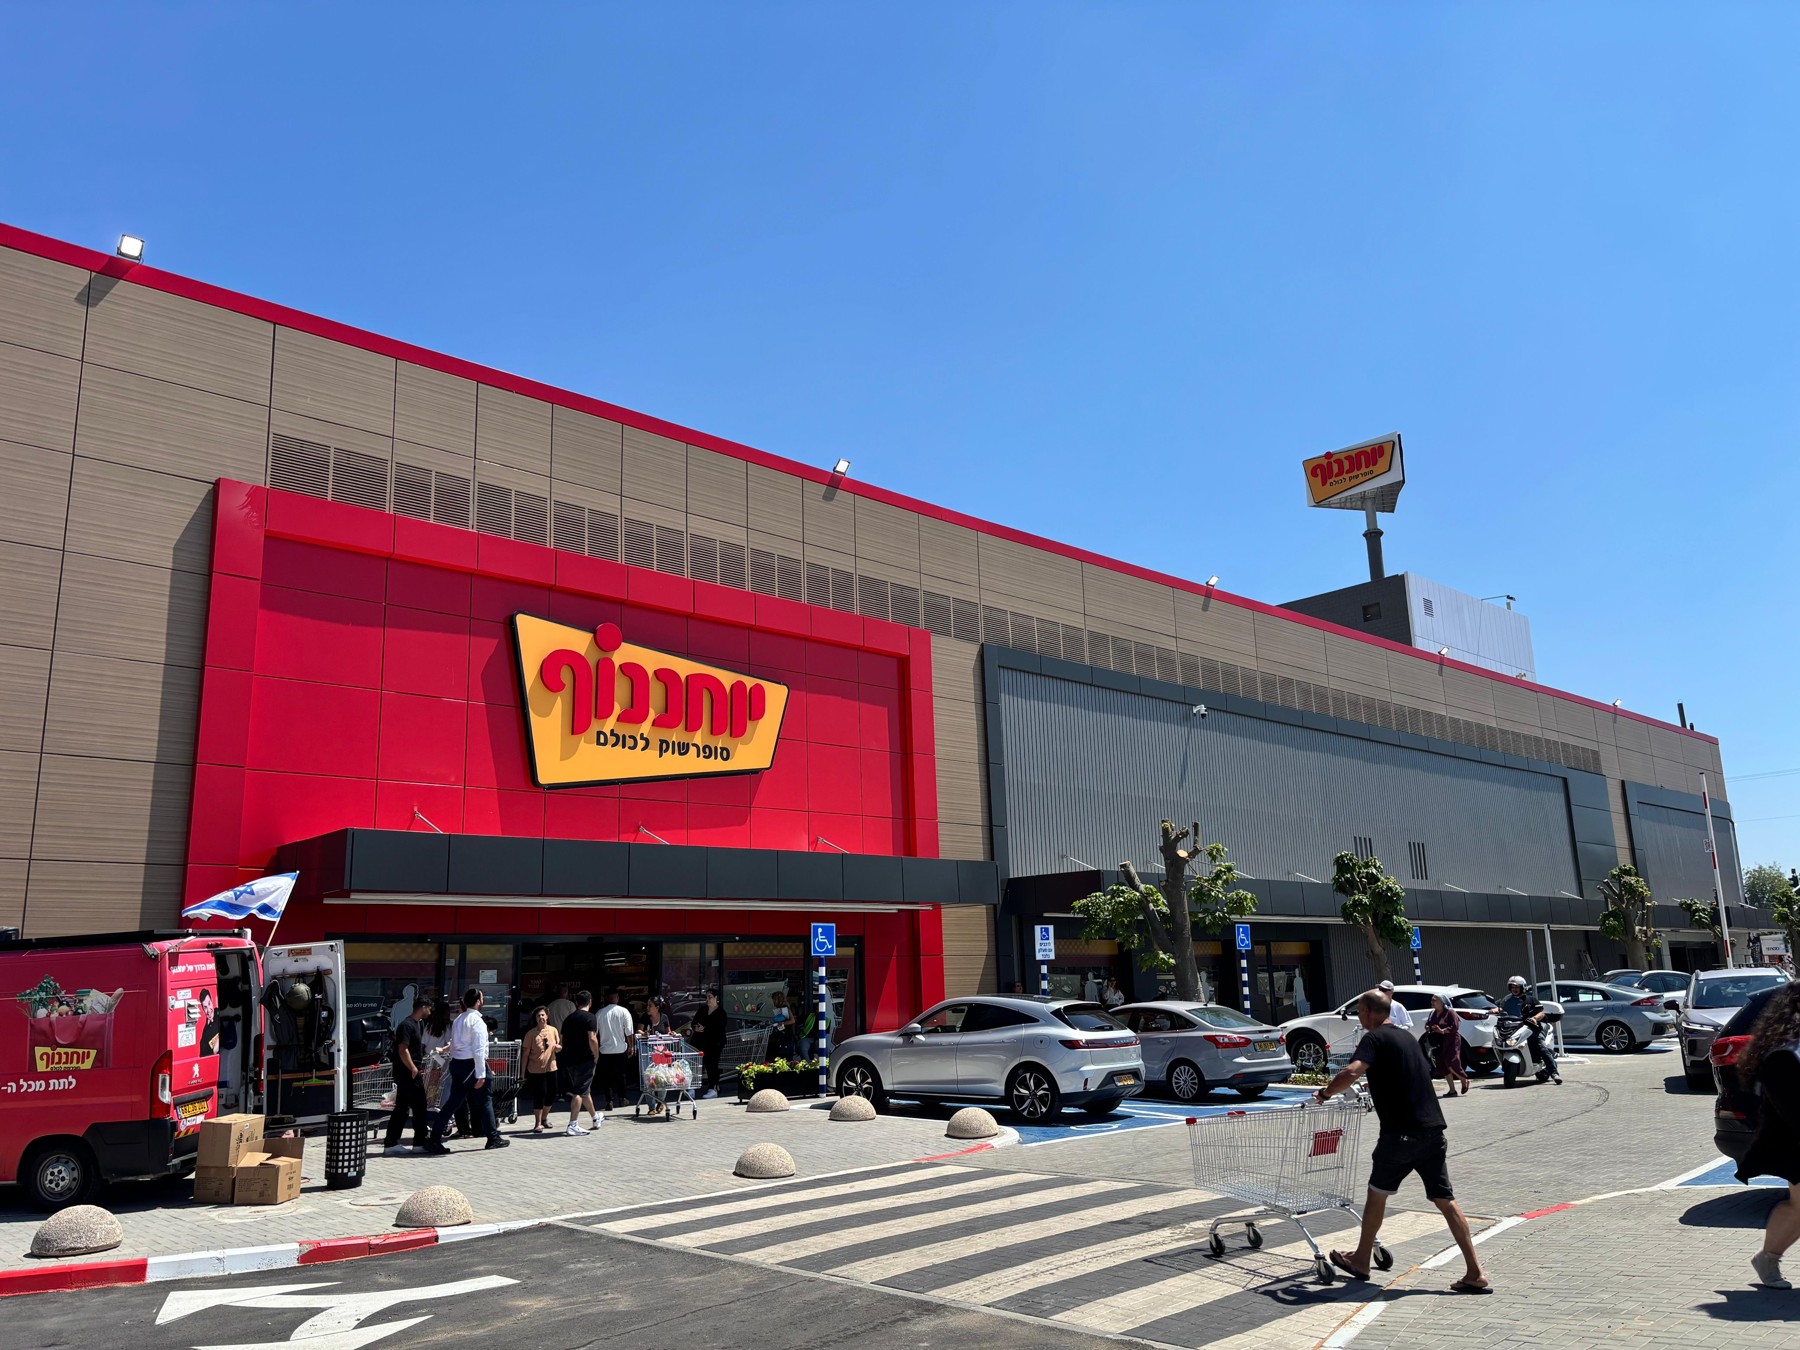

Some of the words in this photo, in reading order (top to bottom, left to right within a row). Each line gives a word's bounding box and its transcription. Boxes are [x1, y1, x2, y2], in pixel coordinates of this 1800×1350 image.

[1310, 445, 1384, 487] יוחננוף
[1348, 469, 1374, 482] סופרשוק
[1328, 477, 1347, 487] לכולם
[540, 622, 766, 738] יוחננוף
[595, 728, 650, 752] לכולם
[658, 738, 731, 762] סופרשוק
[39, 1045, 91, 1070] יוחננוף
[19, 1078, 46, 1093] מכל
[48, 1075, 77, 1091] לתת
